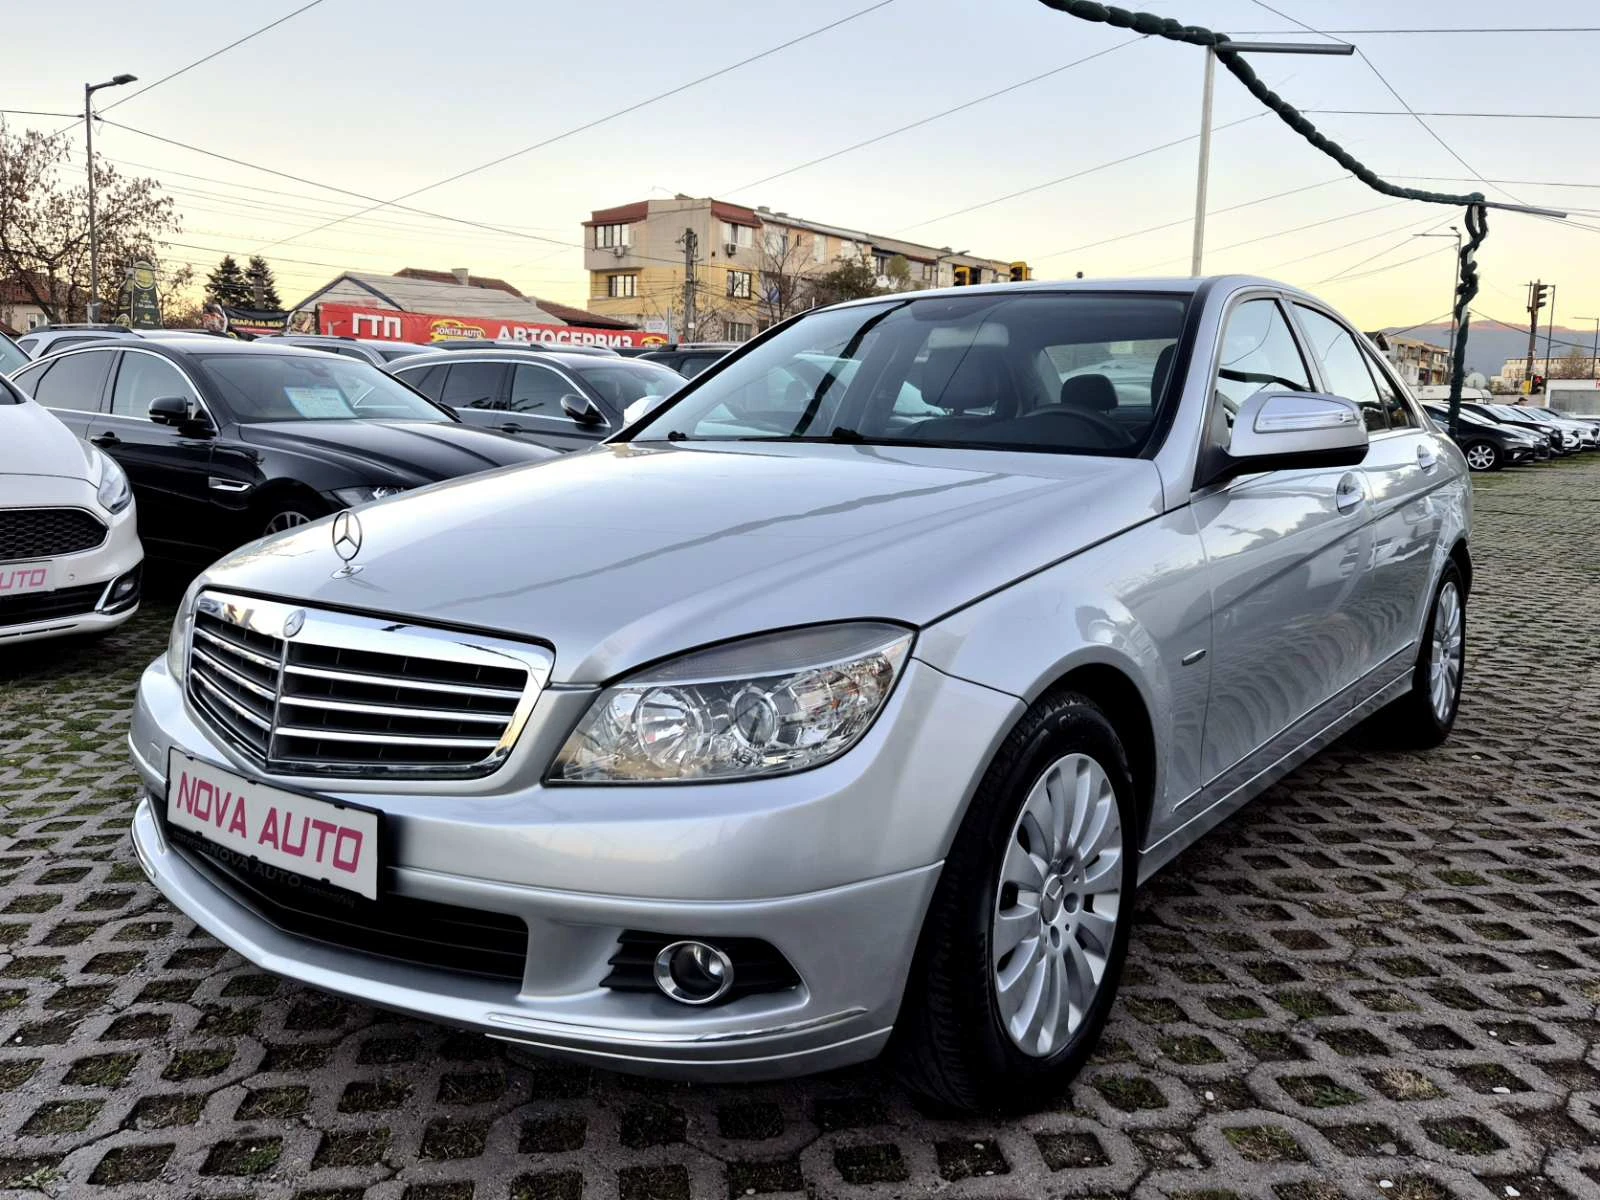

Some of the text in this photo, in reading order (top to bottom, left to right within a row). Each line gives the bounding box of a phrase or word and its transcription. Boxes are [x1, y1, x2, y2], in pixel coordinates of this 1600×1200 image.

[352, 312, 401, 338] ГТП
[463, 329, 482, 338] AUTO
[497, 325, 633, 348] АВТОСЕРВИЗ
[177, 771, 363, 874] NOVA AUTO
[210, 843, 301, 887] NOVA AUTO
